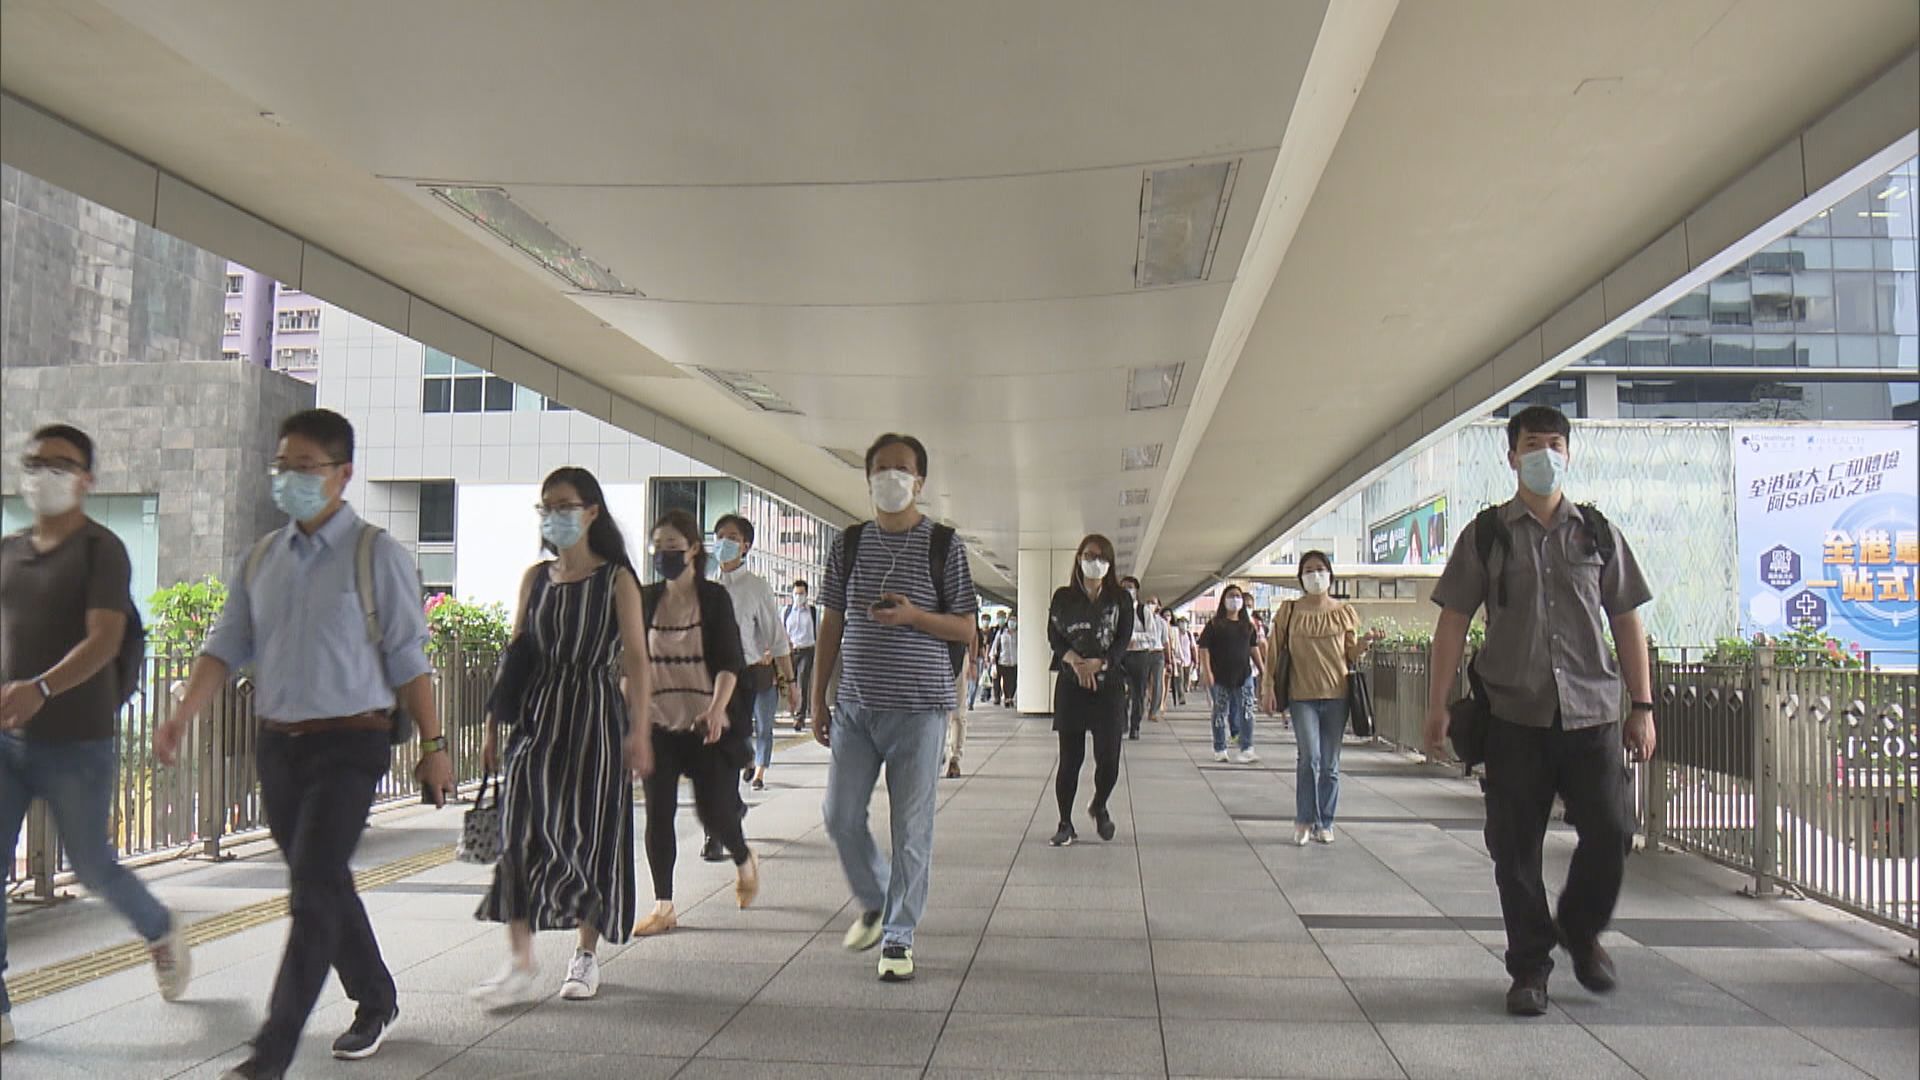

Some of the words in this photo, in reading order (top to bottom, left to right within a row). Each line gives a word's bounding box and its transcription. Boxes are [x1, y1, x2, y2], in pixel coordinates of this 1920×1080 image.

[1748, 467, 1821, 499] 全港最大
[1827, 450, 1899, 481] 仁和體檢
[1767, 474, 1883, 513] 阿Sa信心之選
[1806, 565, 1918, 602] 一站式
